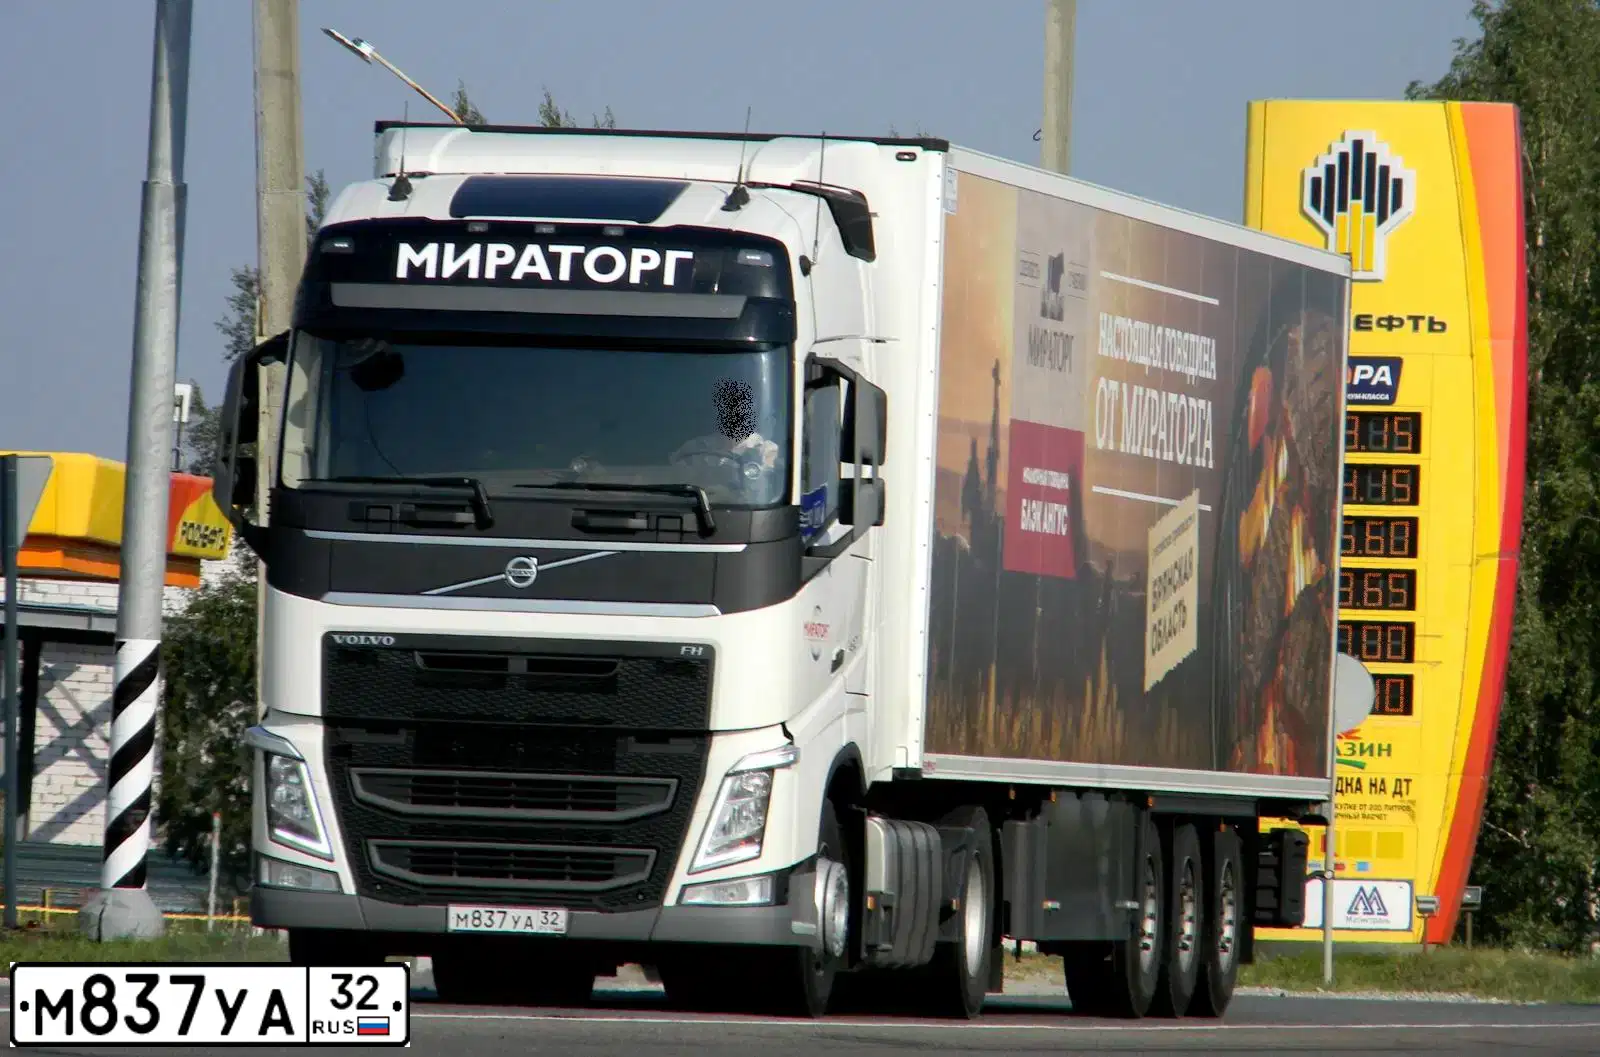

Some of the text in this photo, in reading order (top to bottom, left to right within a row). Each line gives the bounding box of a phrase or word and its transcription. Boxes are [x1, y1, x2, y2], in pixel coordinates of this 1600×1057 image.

[395, 242, 693, 286] МИРАТОРГ
[1353, 314, 1447, 333] ЕФТЬ
[1098, 312, 1217, 385] НАСТОЯЩАЯ ГОВЯДИНА
[1095, 376, 1214, 469] ОТ МИРАТОРГА
[333, 635, 396, 647] VOLVO
[680, 645, 704, 656] FH
[1369, 778, 1387, 795] НА
[1392, 779, 1413, 798] ДТ
[540, 910, 560, 925] 32
